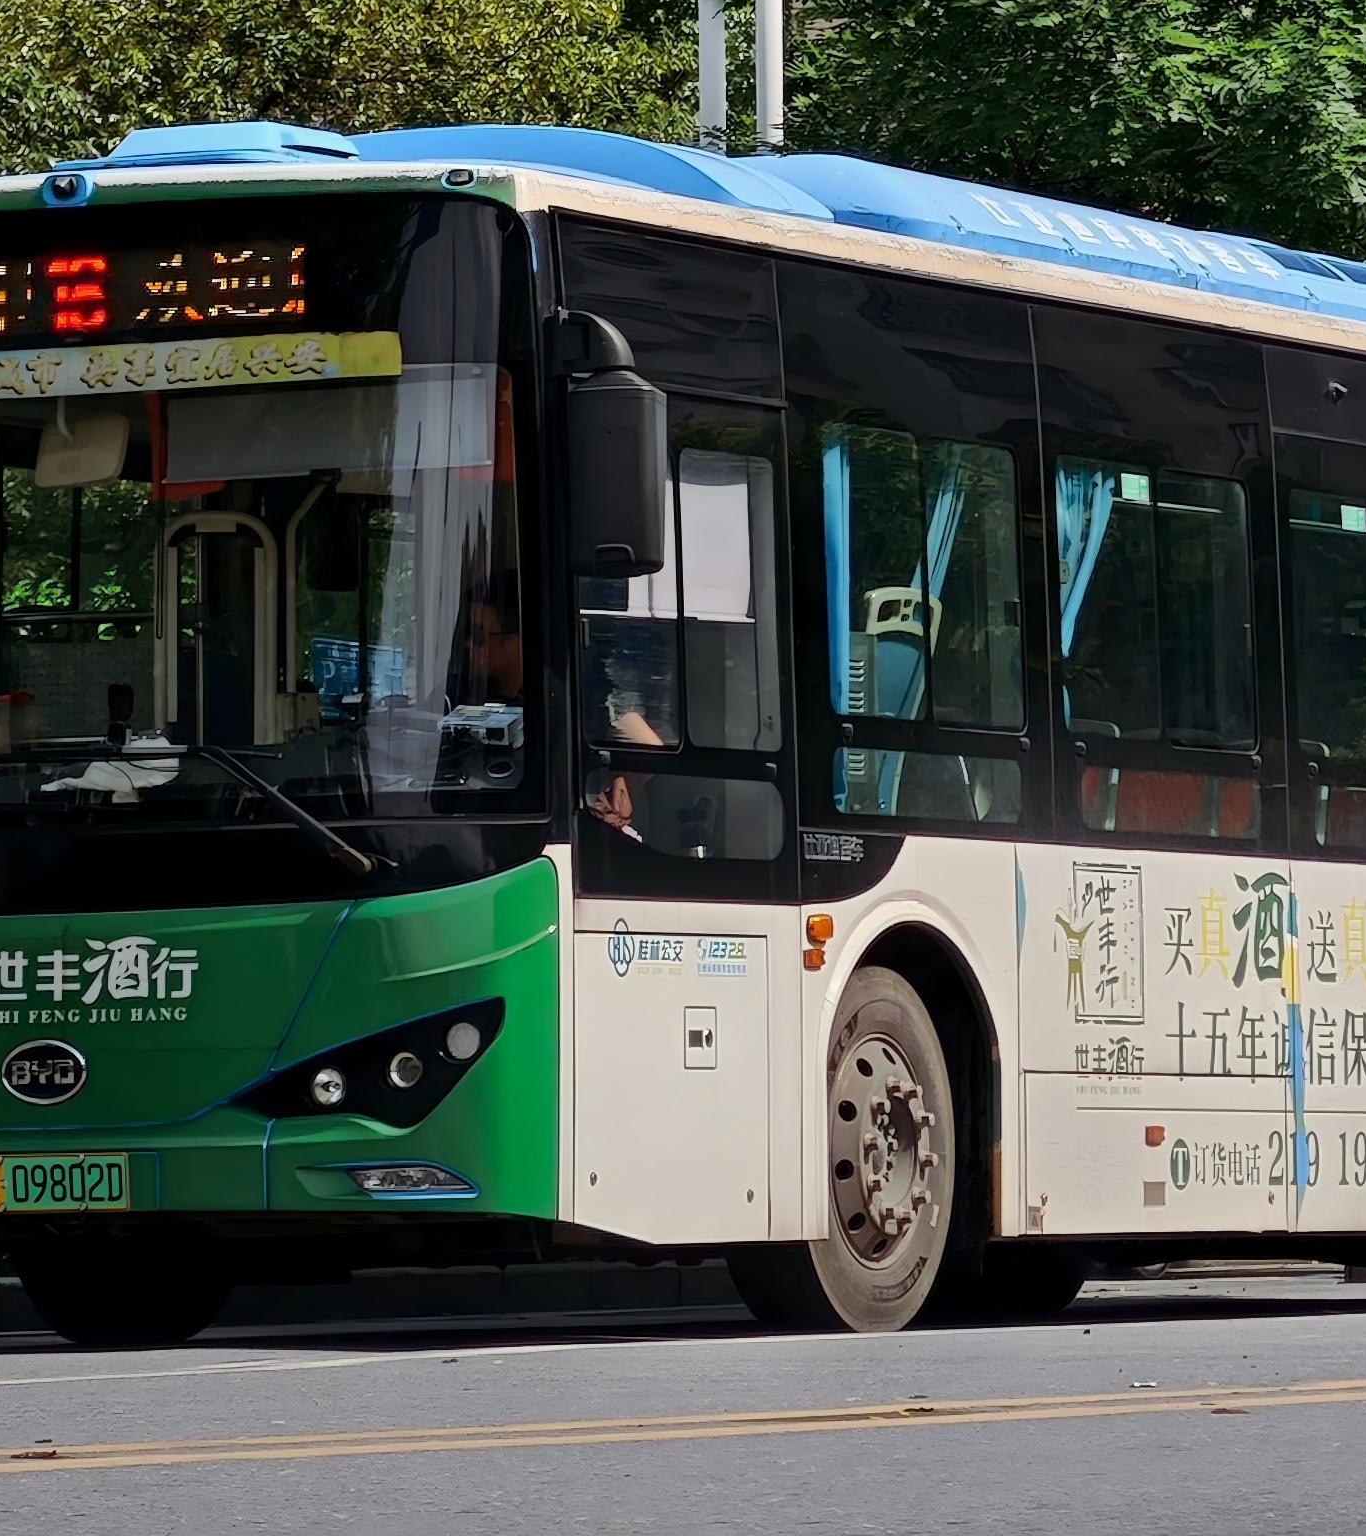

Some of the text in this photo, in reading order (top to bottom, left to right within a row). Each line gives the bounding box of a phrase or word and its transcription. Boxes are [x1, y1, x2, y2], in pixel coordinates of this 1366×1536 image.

[29, 1009, 81, 1024] FENG
[89, 1008, 121, 1024] JIU
[130, 1007, 188, 1023] HANG
[11, 1059, 75, 1085] BYD
[1194, 1142, 1262, 1187] 订货电话
